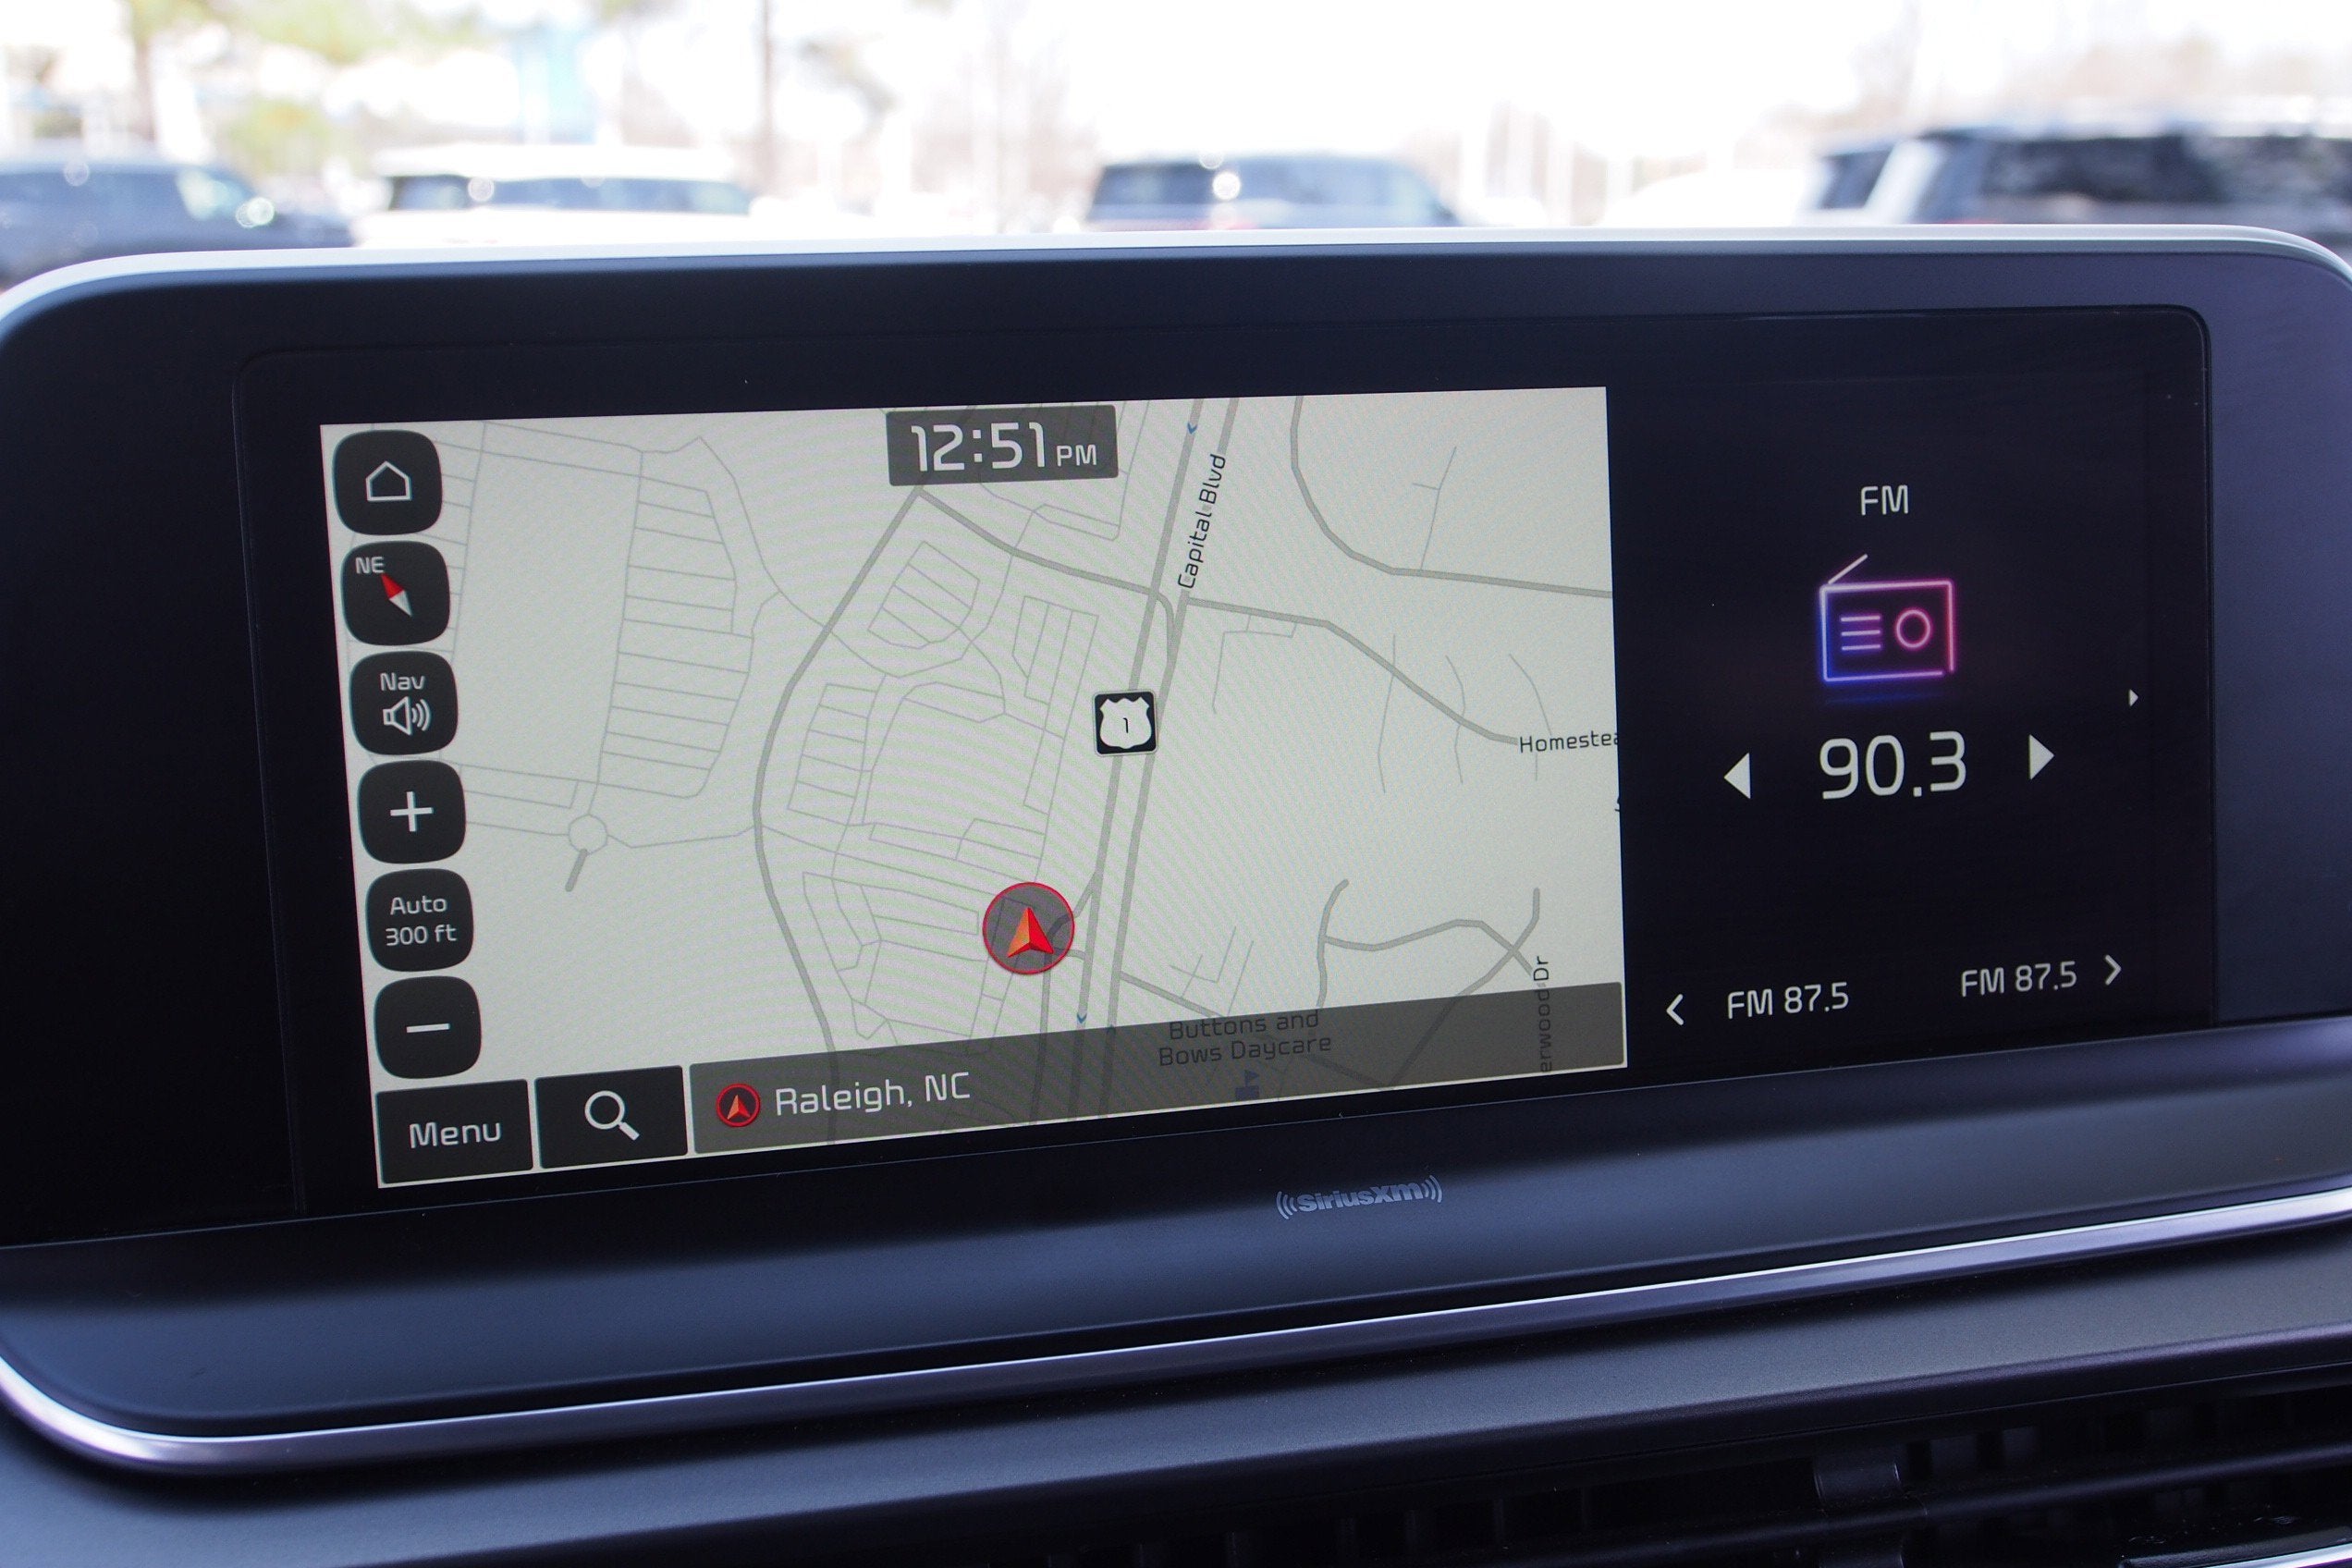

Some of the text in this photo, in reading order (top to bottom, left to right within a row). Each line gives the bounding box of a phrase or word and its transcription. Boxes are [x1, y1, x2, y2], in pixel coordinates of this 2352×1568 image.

[911, 422, 1097, 472] 12:51 PM
[1860, 485, 1909, 515] FM
[1177, 454, 1226, 589] Capital Blvd
[355, 556, 386, 575] NE
[379, 671, 426, 692] Nav
[1121, 717, 1130, 734] 1
[1819, 730, 1967, 800] 90.3
[389, 895, 447, 916] Auto
[385, 924, 458, 947] 300 ft
[1533, 956, 1550, 981] Dr
[1961, 961, 2078, 997] FM 87.5
[1727, 982, 1850, 1020] FM 87.5
[1170, 1010, 1319, 1040] Buttons and
[1159, 1036, 1331, 1066] Bows Daycare
[775, 1072, 971, 1116] Raleigh, NC
[409, 1121, 502, 1149] Menu
